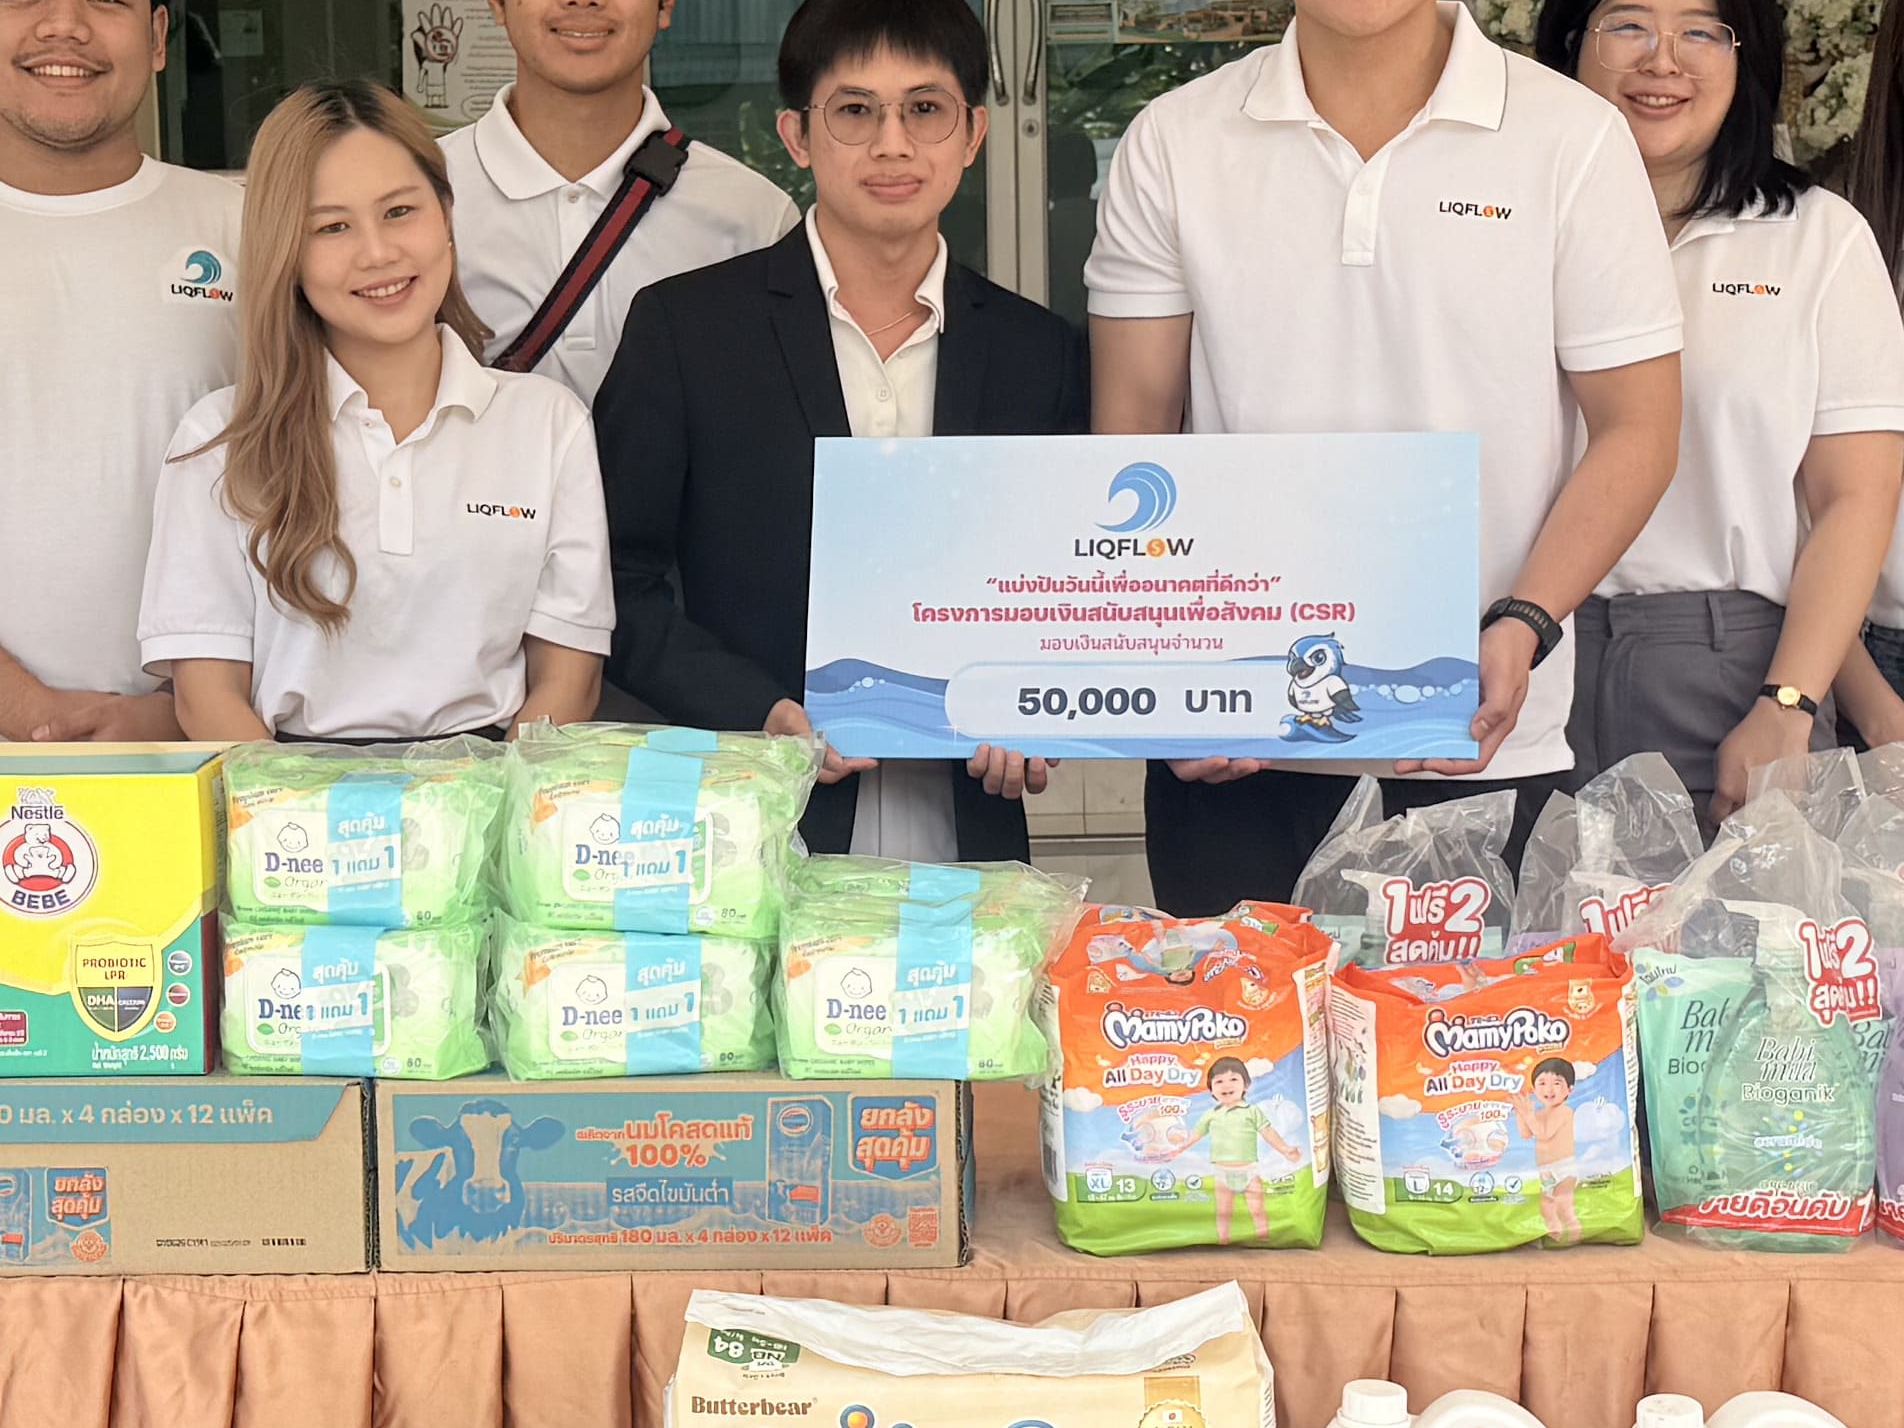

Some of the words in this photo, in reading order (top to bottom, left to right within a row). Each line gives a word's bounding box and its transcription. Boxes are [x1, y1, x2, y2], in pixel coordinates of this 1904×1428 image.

[1438, 200, 1513, 220] LIQFLOW
[171, 283, 234, 303] LIQFLOW
[1711, 280, 1782, 298] LIQFLOW
[466, 501, 537, 521] LIQFLOW
[1074, 537, 1194, 560] LIQFLOW
[913, 600, 1282, 629] โครงการมอบเงินสนับสนุนเพื่อสังคม
[1290, 602, 1356, 623] (CSR)
[1040, 634, 1224, 657] มอบเงินสนับสนุนจำนวน
[1017, 686, 1156, 719] 50,000
[1185, 689, 1253, 713] บาท
[337, 811, 385, 836] สุดคุ้ม
[630, 812, 680, 837] สุดคุ้ม
[264, 851, 324, 873] D-nee
[11, 888, 71, 909] BEBE
[81, 956, 147, 969] PROBIOTIC
[312, 959, 359, 984] สุดคุ้ม
[637, 957, 685, 983] สุดคุ้ม
[906, 960, 957, 985] สุดคุ้ม
[86, 994, 115, 1008] DHA
[825, 998, 887, 1020] D-nee
[562, 1006, 623, 1026] D-nee
[1104, 1003, 1246, 1048] MamyPoko
[1425, 1009, 1569, 1056] MamyPoko
[1131, 1055, 1175, 1066] Happy
[1755, 1037, 1816, 1062] Babi
[1105, 1070, 1126, 1084] All
[1130, 1068, 1164, 1084] Day
[1168, 1069, 1199, 1084] Dry
[1452, 1062, 1497, 1072] Happy
[1426, 1077, 1448, 1092] All
[1453, 1076, 1485, 1090] Day
[1490, 1075, 1521, 1090] Dry
[19, 1106, 56, 1125] มล.
[61, 1109, 73, 1124] x
[78, 1105, 93, 1124] 4
[100, 1102, 165, 1126] กล่อง
[170, 1108, 181, 1124] x
[187, 1104, 214, 1124] 12
[220, 1097, 274, 1125] แพ็ค
[860, 1104, 934, 1130] ยกลัง
[625, 1144, 707, 1167] 100%
[857, 1131, 931, 1171] สุดคุ้ม
[612, 1180, 729, 1203] รสจืดไขมันต่ำ
[692, 1396, 812, 1416] Butterbear
